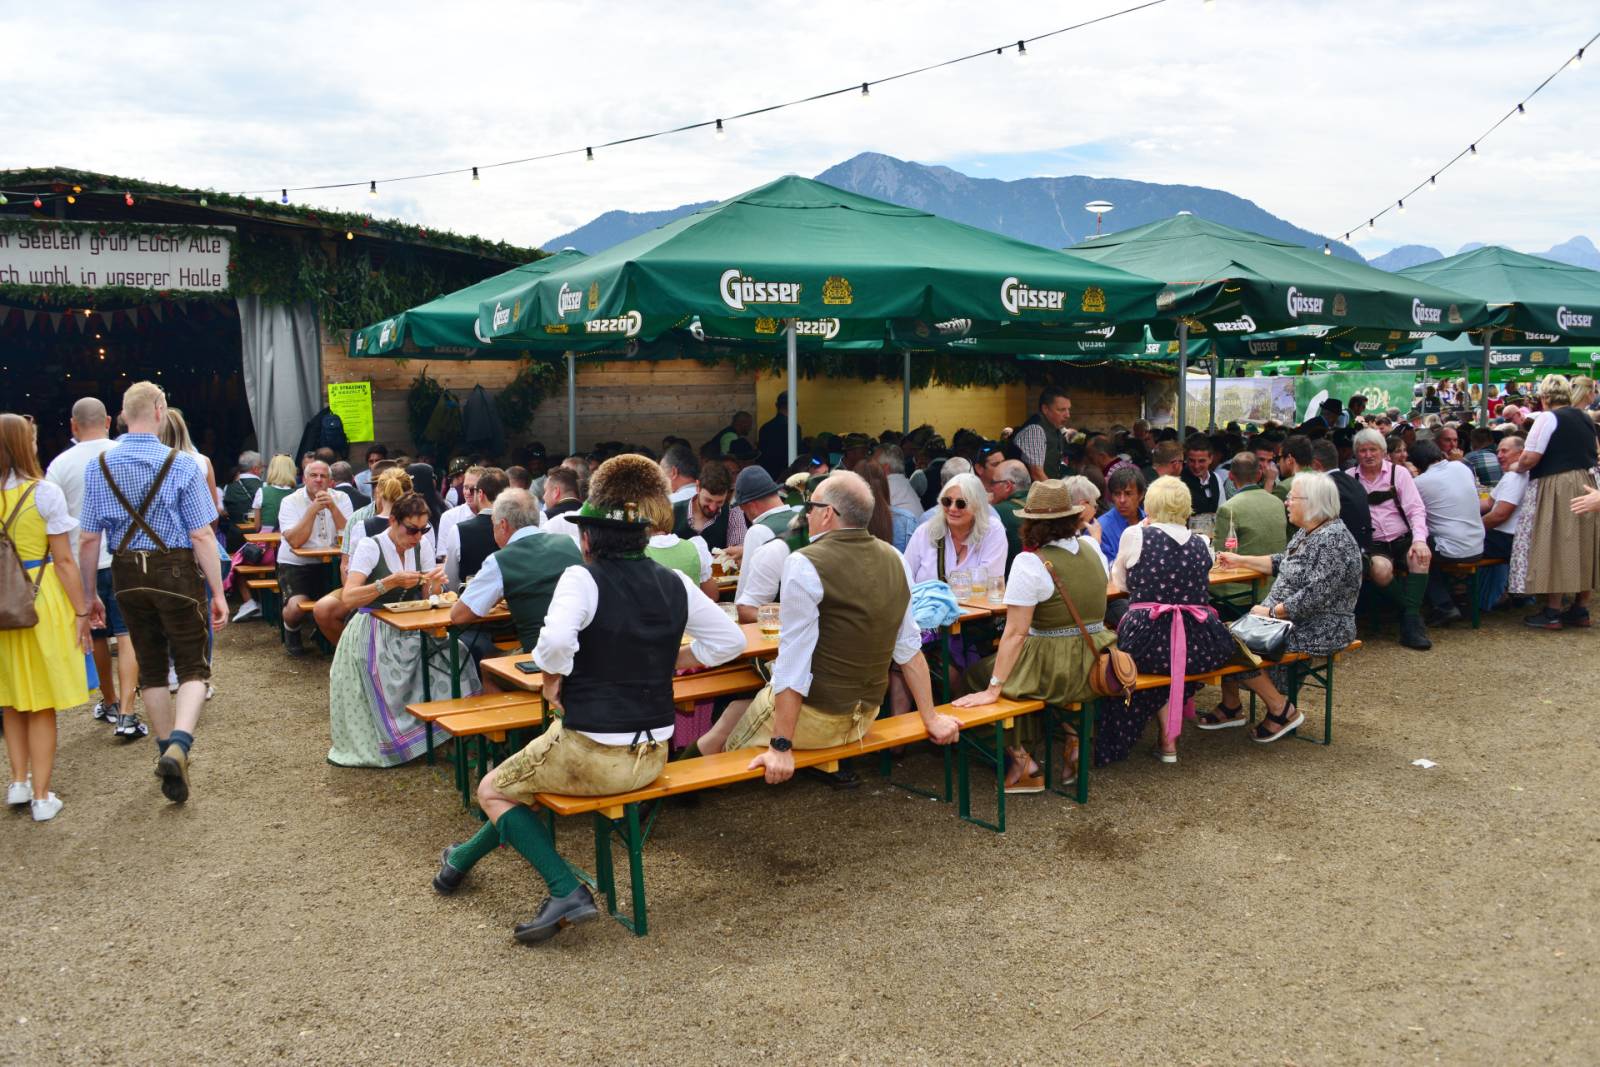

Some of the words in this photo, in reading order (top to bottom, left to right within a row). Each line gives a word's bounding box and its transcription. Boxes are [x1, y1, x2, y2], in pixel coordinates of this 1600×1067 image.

[19, 231, 81, 250] Seelen
[138, 235, 179, 252] Euch
[189, 235, 221, 254] Alle
[30, 265, 71, 286] wohl
[81, 267, 97, 286] in
[106, 270, 170, 287] unserer
[720, 269, 801, 310] Gösser
[558, 282, 583, 318] Gösser
[1000, 276, 1066, 315] Gösser
[1287, 286, 1324, 318] Gösser
[1412, 297, 1442, 326] Gösser
[1557, 305, 1593, 331] Gösser
[1489, 350, 1522, 365] Gösser
